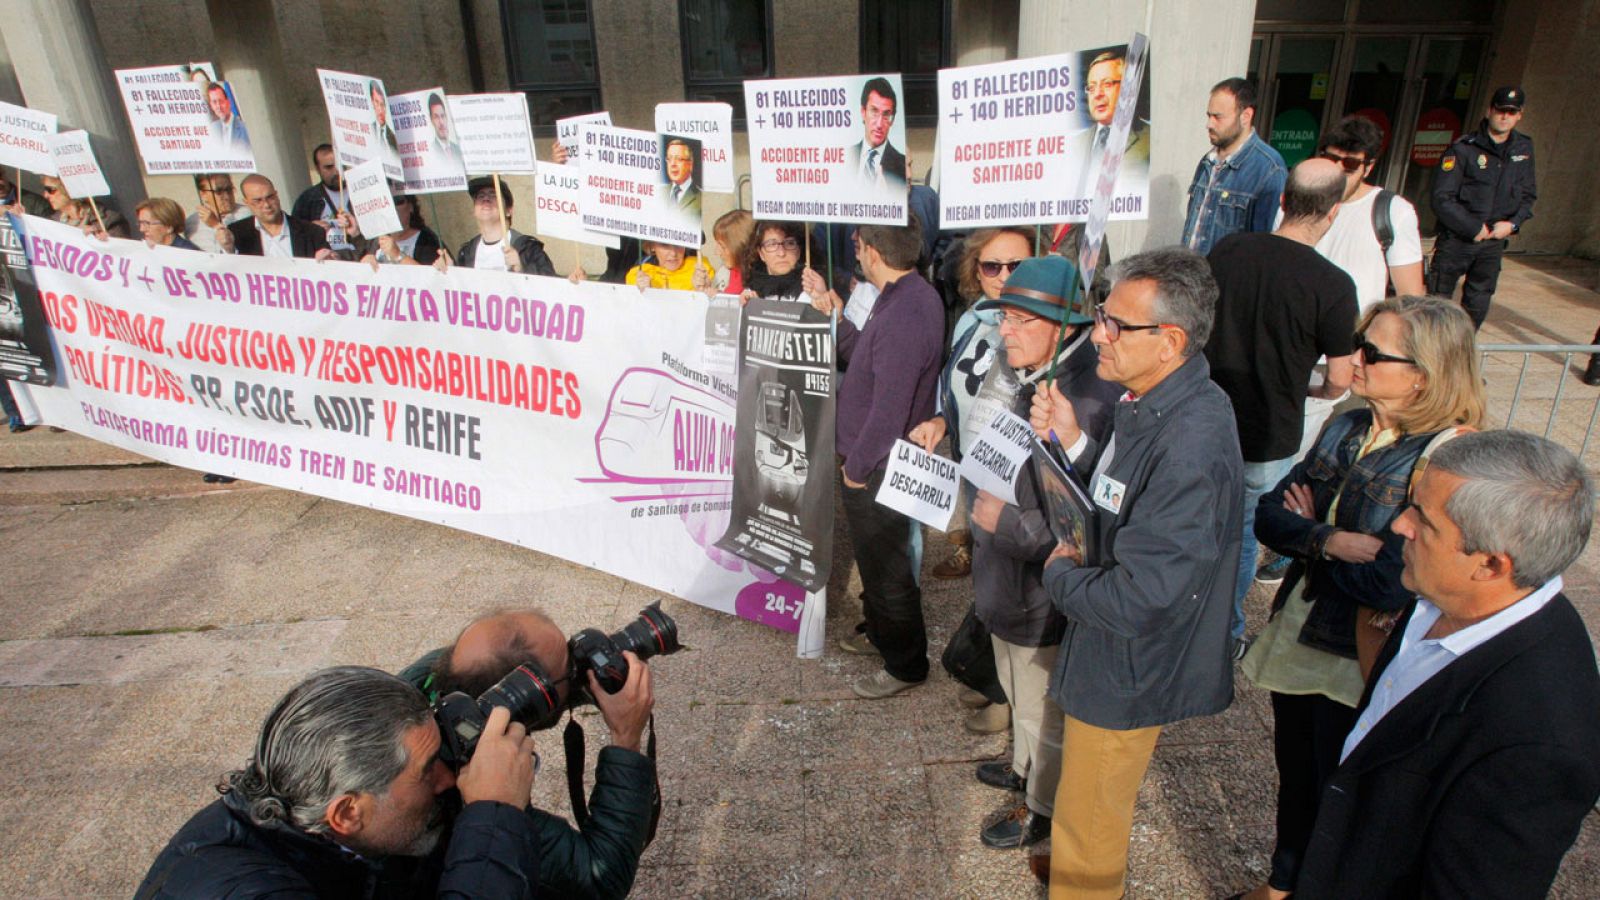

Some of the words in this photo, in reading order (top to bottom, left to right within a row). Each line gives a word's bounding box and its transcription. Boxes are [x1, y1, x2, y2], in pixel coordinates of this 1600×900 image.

[952, 80, 968, 100] 81
[974, 66, 1070, 98] FALLECIDOS
[131, 90, 143, 101] 81
[145, 89, 201, 101] FALLECIDOS
[755, 92, 769, 108] 81
[773, 88, 846, 107] FALLECIDOS
[147, 104, 166, 115] 140
[168, 103, 209, 114] HERIDOS
[949, 107, 963, 124] +
[970, 100, 998, 122] 140
[1004, 91, 1076, 118] HERIDOS
[4, 115, 48, 133] JUSTICIA
[665, 121, 677, 132] LA
[680, 120, 719, 133] JUSTICIA
[755, 115, 766, 129] +
[772, 111, 793, 128] 140
[798, 109, 851, 128] HERIDOS
[144, 126, 191, 137] ACCIDENTE
[193, 126, 209, 136] AVE
[1271, 130, 1315, 140] ENTRADA
[160, 139, 202, 150] SANTIAGO
[586, 131, 597, 145] 81
[600, 133, 657, 154] FALLECIDOS
[954, 139, 1032, 163] ACCIDENTE
[1037, 136, 1065, 155] AVE
[584, 150, 593, 160] +
[597, 149, 615, 164] 140
[618, 152, 661, 171] HERIDOS
[702, 148, 726, 162] RILA
[761, 147, 820, 163] ACCIDENTE
[823, 147, 845, 163] AVE
[544, 174, 556, 186] LA
[560, 177, 579, 190] JUS
[776, 168, 829, 184] SANTIAGO
[972, 161, 1044, 184] SANTIAGO
[588, 175, 634, 194] ACCIDENTE
[637, 183, 655, 196] AVE
[537, 197, 578, 215] DESCA
[599, 191, 642, 210] SANTIAGO
[757, 200, 783, 214] NIEGAN
[785, 201, 825, 216] COMISIÓN
[827, 203, 838, 216] DE
[839, 202, 903, 219] INVESTIGACIÓN
[945, 204, 981, 221] NIEGAN
[984, 199, 1036, 219] COMISIÓN
[1040, 201, 1054, 216] DE
[583, 214, 605, 226] NIEGAN
[639, 223, 648, 236] DE
[30, 235, 113, 281] ECIDOS
[119, 257, 131, 288] Y
[163, 266, 197, 296] DE
[194, 271, 241, 303] 140
[246, 273, 349, 316] HERIDOS
[356, 284, 381, 318] EN
[382, 285, 439, 322] ALTA
[444, 290, 585, 343] VELOCIDAD
[746, 325, 831, 364] FRANKENSTEIN
[177, 322, 295, 374] JUSTICIA
[297, 336, 316, 377] Y
[317, 338, 582, 419] RESPONSABILIDADES
[314, 394, 375, 437] ADIF
[384, 400, 397, 442] Y
[405, 404, 482, 461] RENFE
[991, 412, 1007, 430] LA
[673, 408, 716, 473] ALVIA
[81, 401, 188, 449] PLATAFORMA
[196, 427, 292, 469] VÍCTIMAS
[300, 448, 345, 481] TREN
[353, 461, 376, 487] DE
[383, 466, 482, 511] SANTIAGO
[898, 445, 910, 463] LA
[912, 451, 956, 482] JUSTICIA
[970, 439, 1017, 485] DESCARRILA
[889, 471, 952, 511] DESCARRILA
[630, 505, 644, 519] de
[647, 501, 689, 516] Santiago
[692, 501, 701, 512] de
